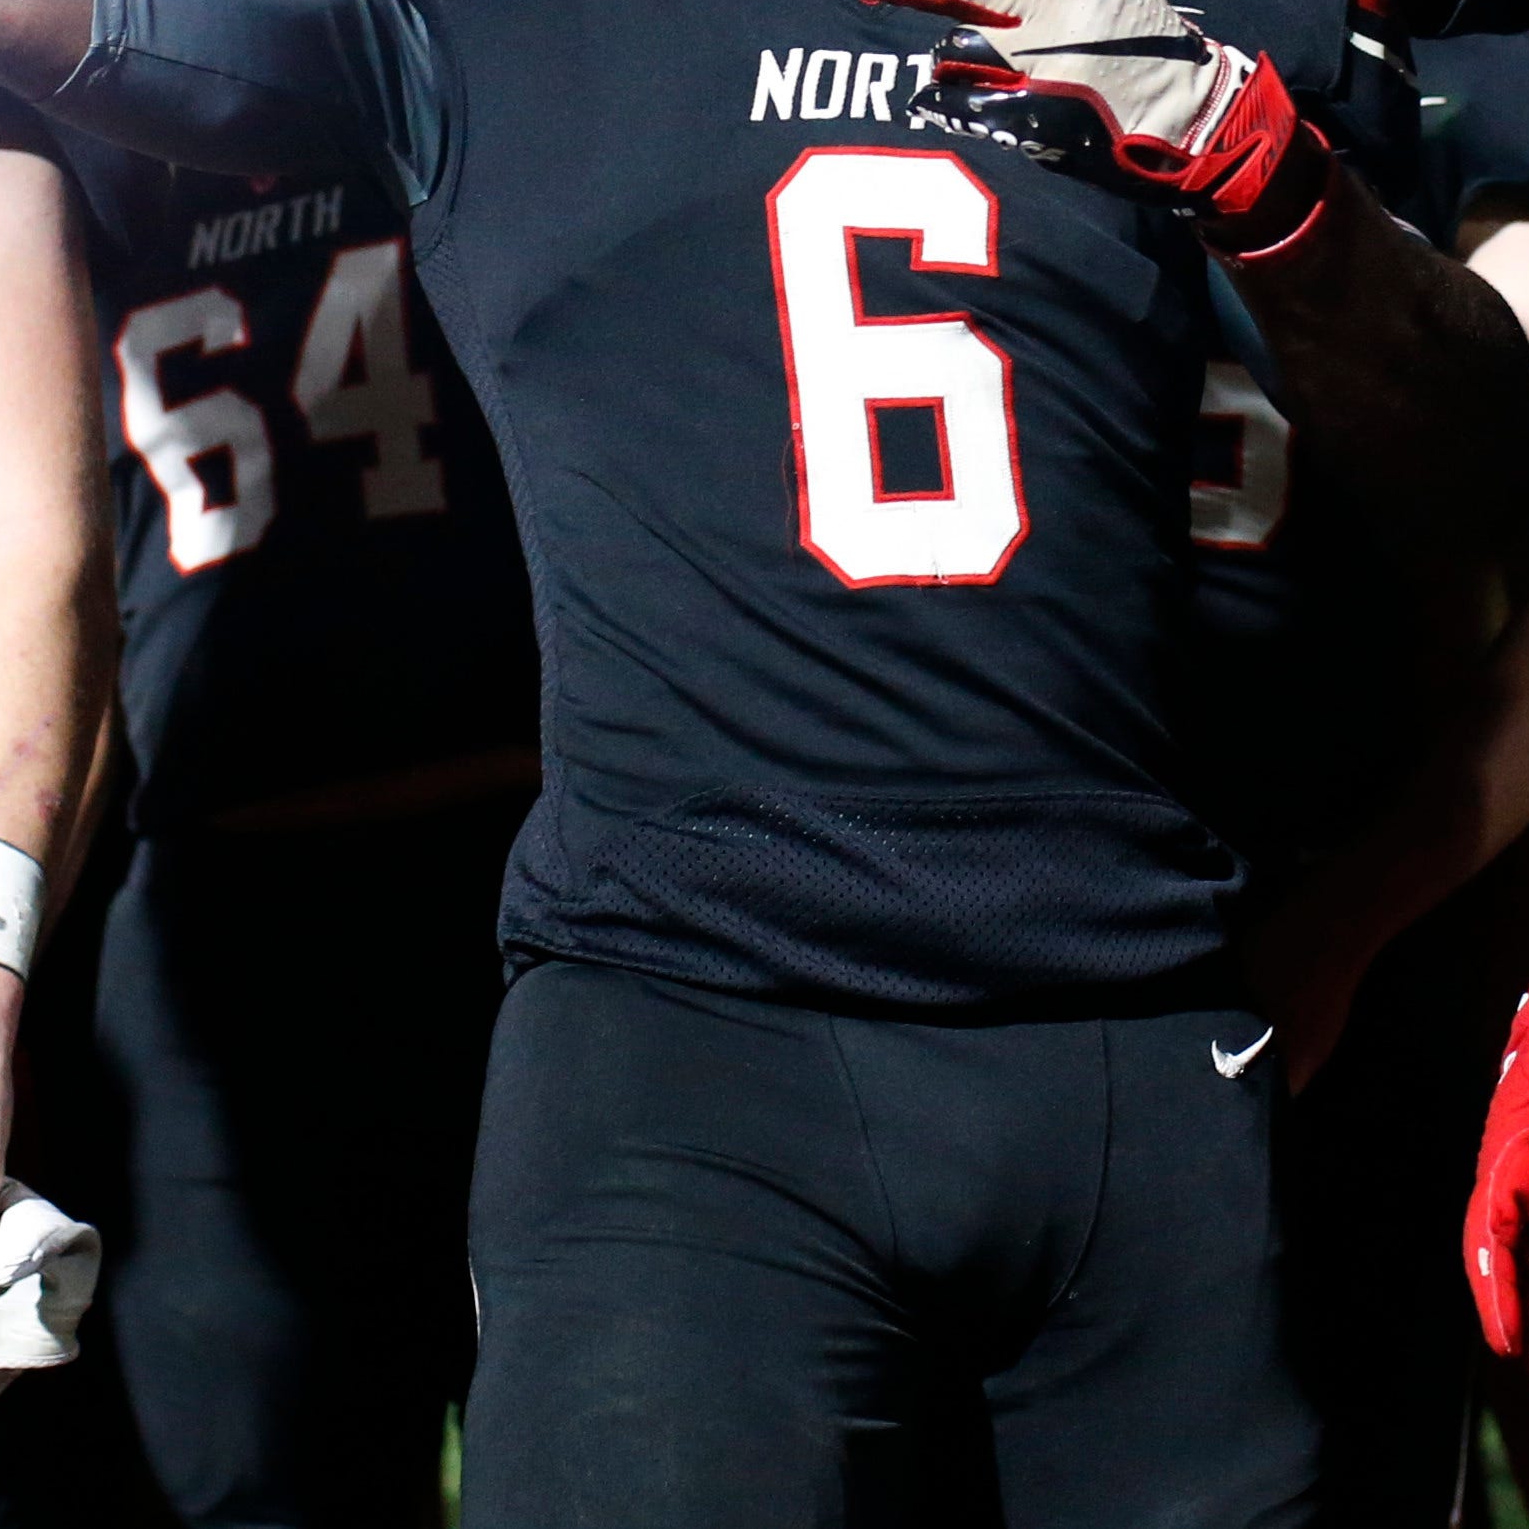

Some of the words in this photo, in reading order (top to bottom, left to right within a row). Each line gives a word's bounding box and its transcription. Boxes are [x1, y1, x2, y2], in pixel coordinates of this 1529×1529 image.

[749, 47, 934, 131] NORT
[186, 185, 346, 270] NORTH
[114, 236, 450, 578] 64
[765, 146, 1030, 589] 6
